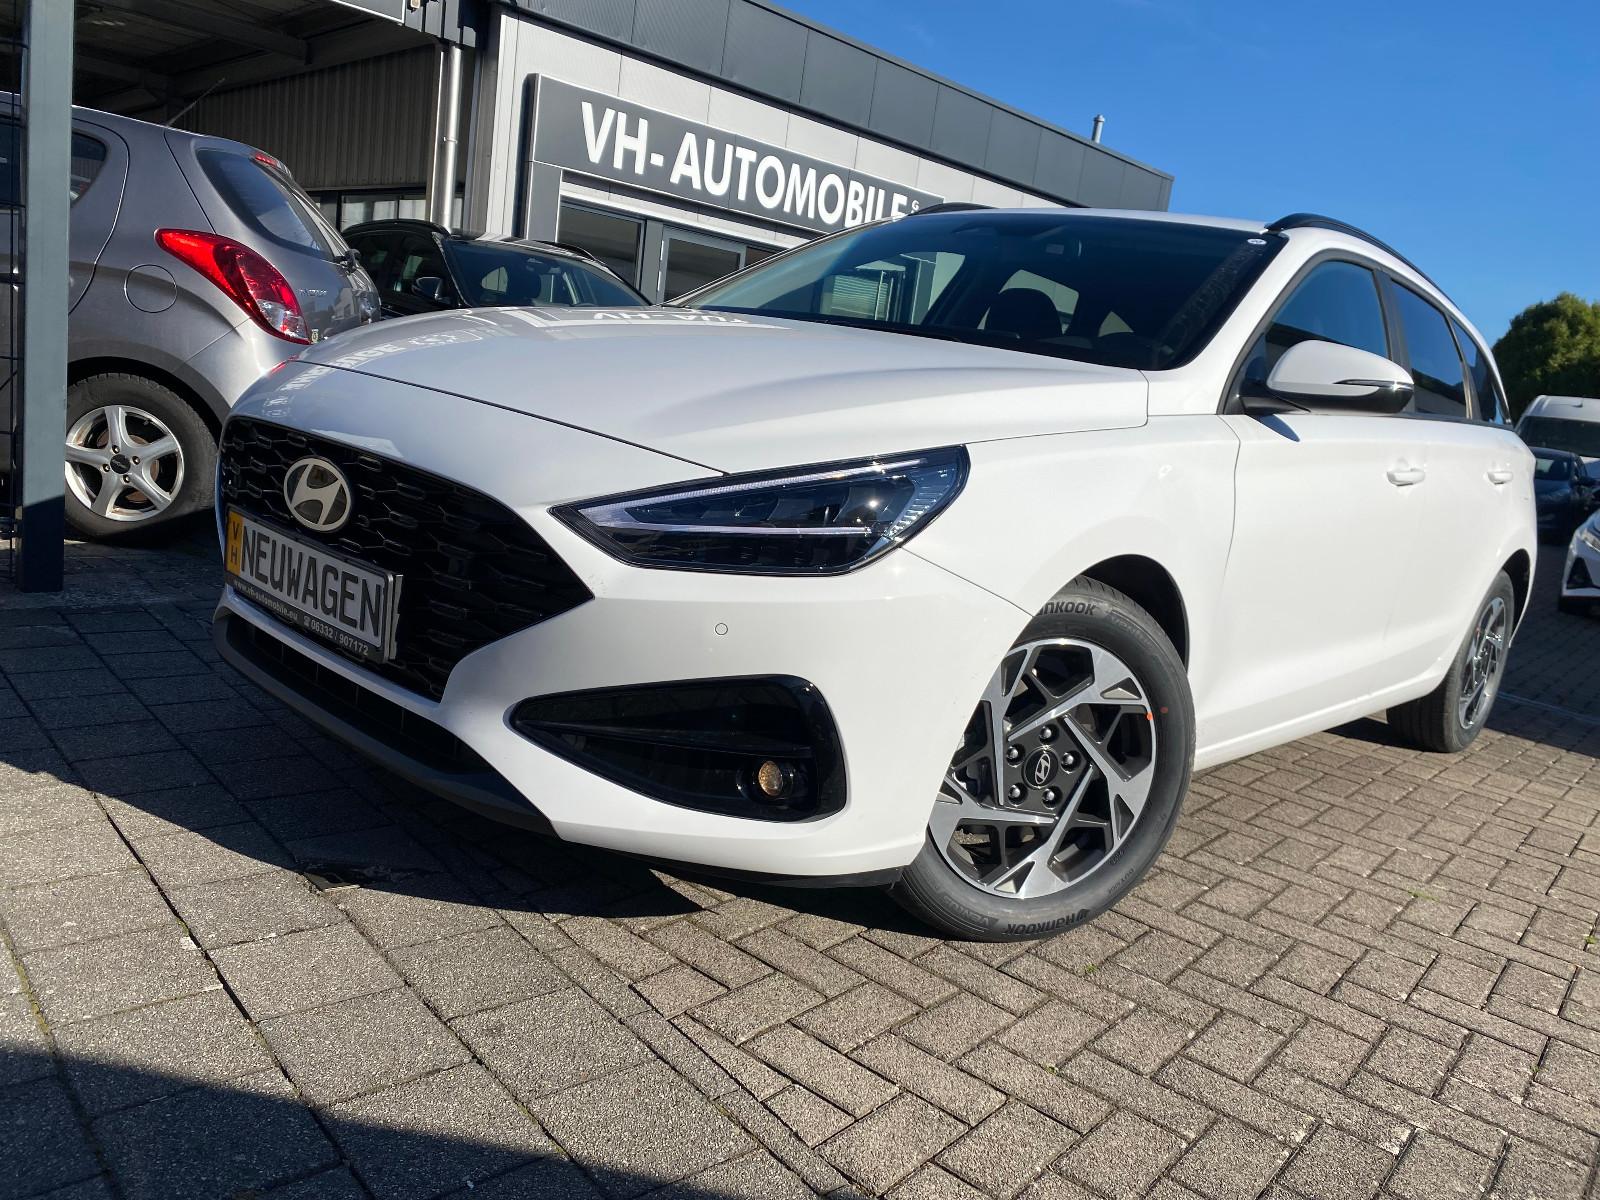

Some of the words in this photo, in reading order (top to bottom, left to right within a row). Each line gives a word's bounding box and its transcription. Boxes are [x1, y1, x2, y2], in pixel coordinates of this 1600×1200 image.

[581, 101, 664, 175] VH-
[669, 131, 908, 229] AUTOMOBILE
[241, 525, 382, 637] NEUWAGEN
[310, 618, 333, 639] 06332
[339, 634, 369, 656] 907172
